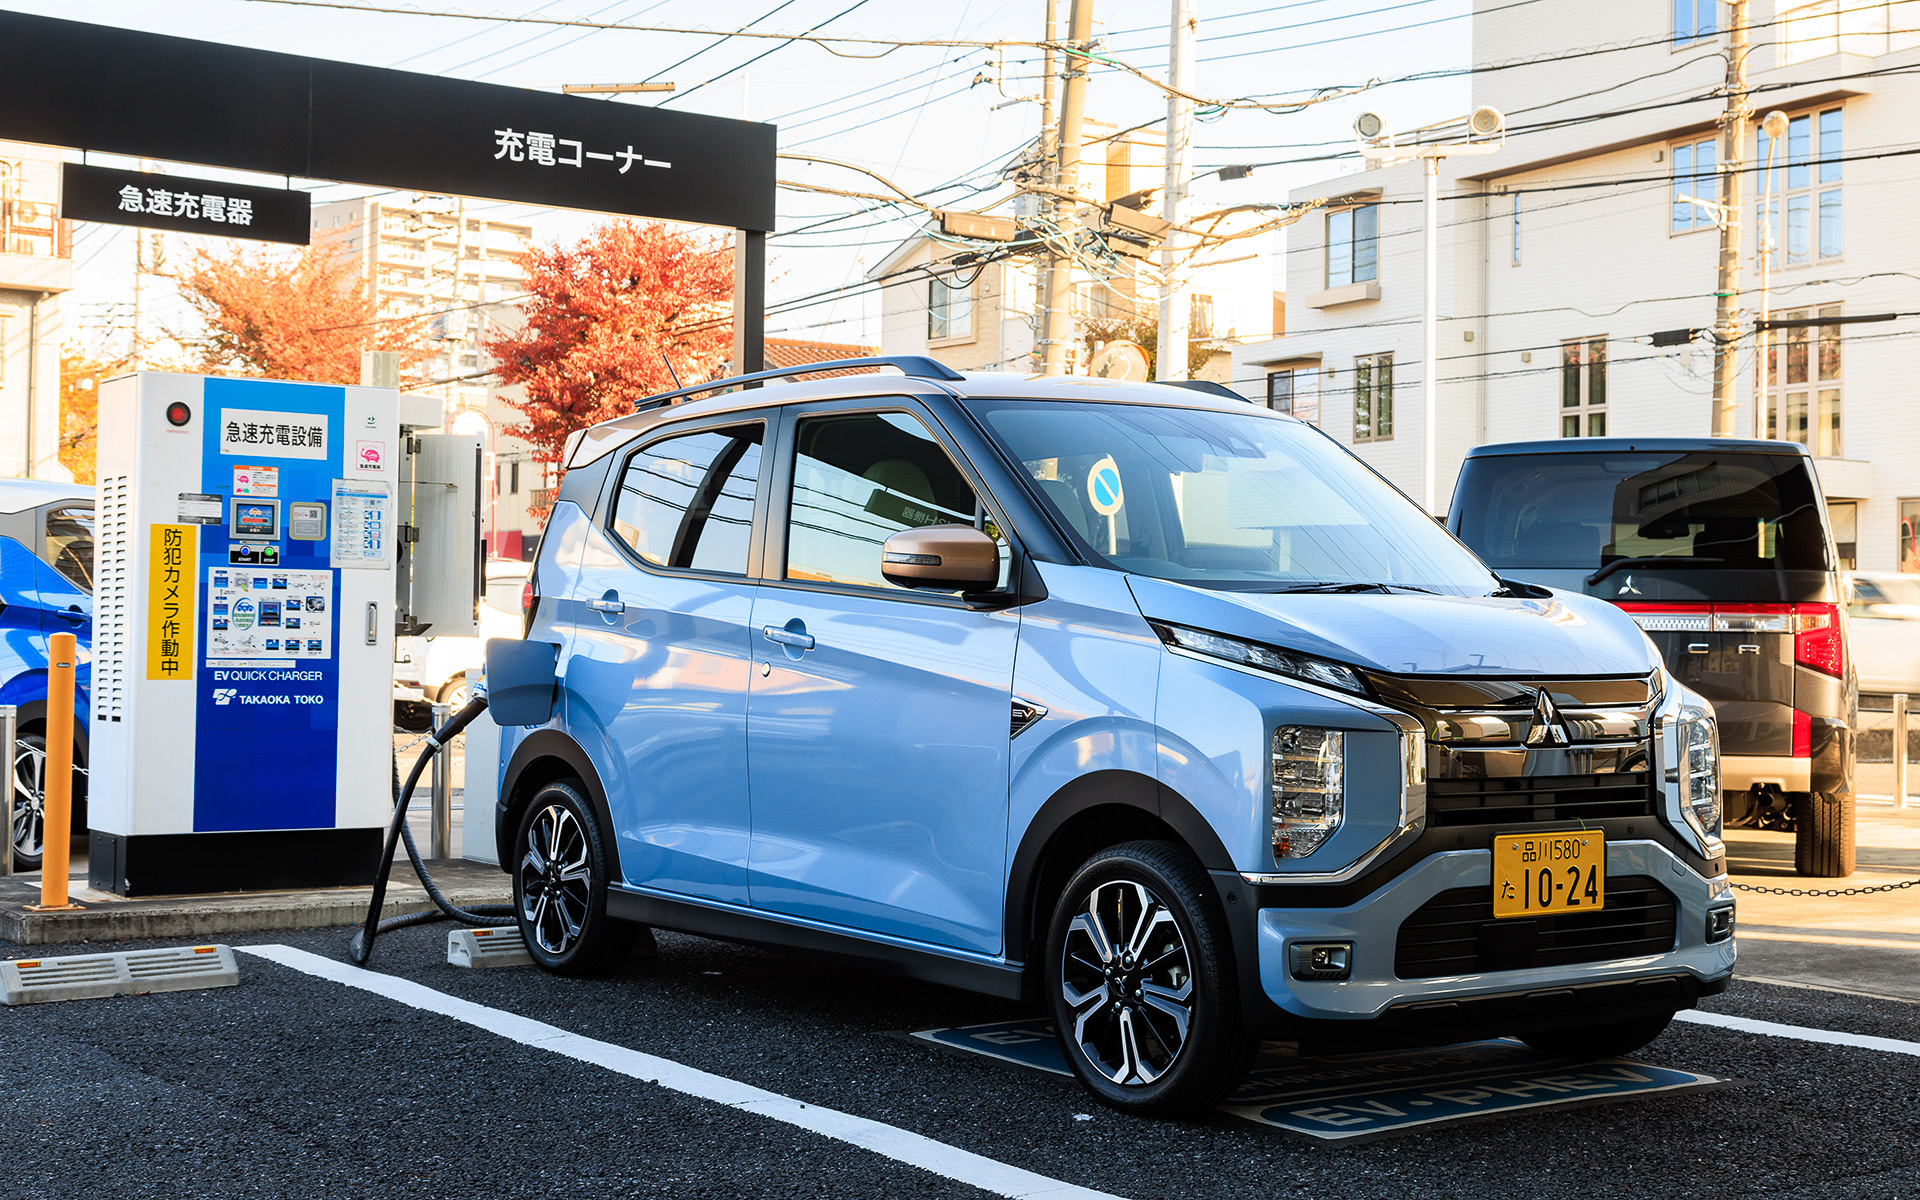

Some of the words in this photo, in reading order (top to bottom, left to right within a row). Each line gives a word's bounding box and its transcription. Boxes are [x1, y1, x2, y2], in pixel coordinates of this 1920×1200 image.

[493, 127, 673, 175] 充電コーナー
[117, 184, 254, 226] 急速充電器
[225, 420, 323, 448] 急速充電設備
[160, 527, 183, 677] 防犯カメラ作動中
[213, 670, 230, 681] EV
[230, 670, 267, 682] QUICK
[268, 670, 324, 682] CHARGER
[239, 694, 291, 705] TAKAOKA
[293, 694, 325, 705] TOKO
[1012, 708, 1035, 718] EV
[1501, 878, 1516, 900] た
[1524, 864, 1599, 910] 10-24
